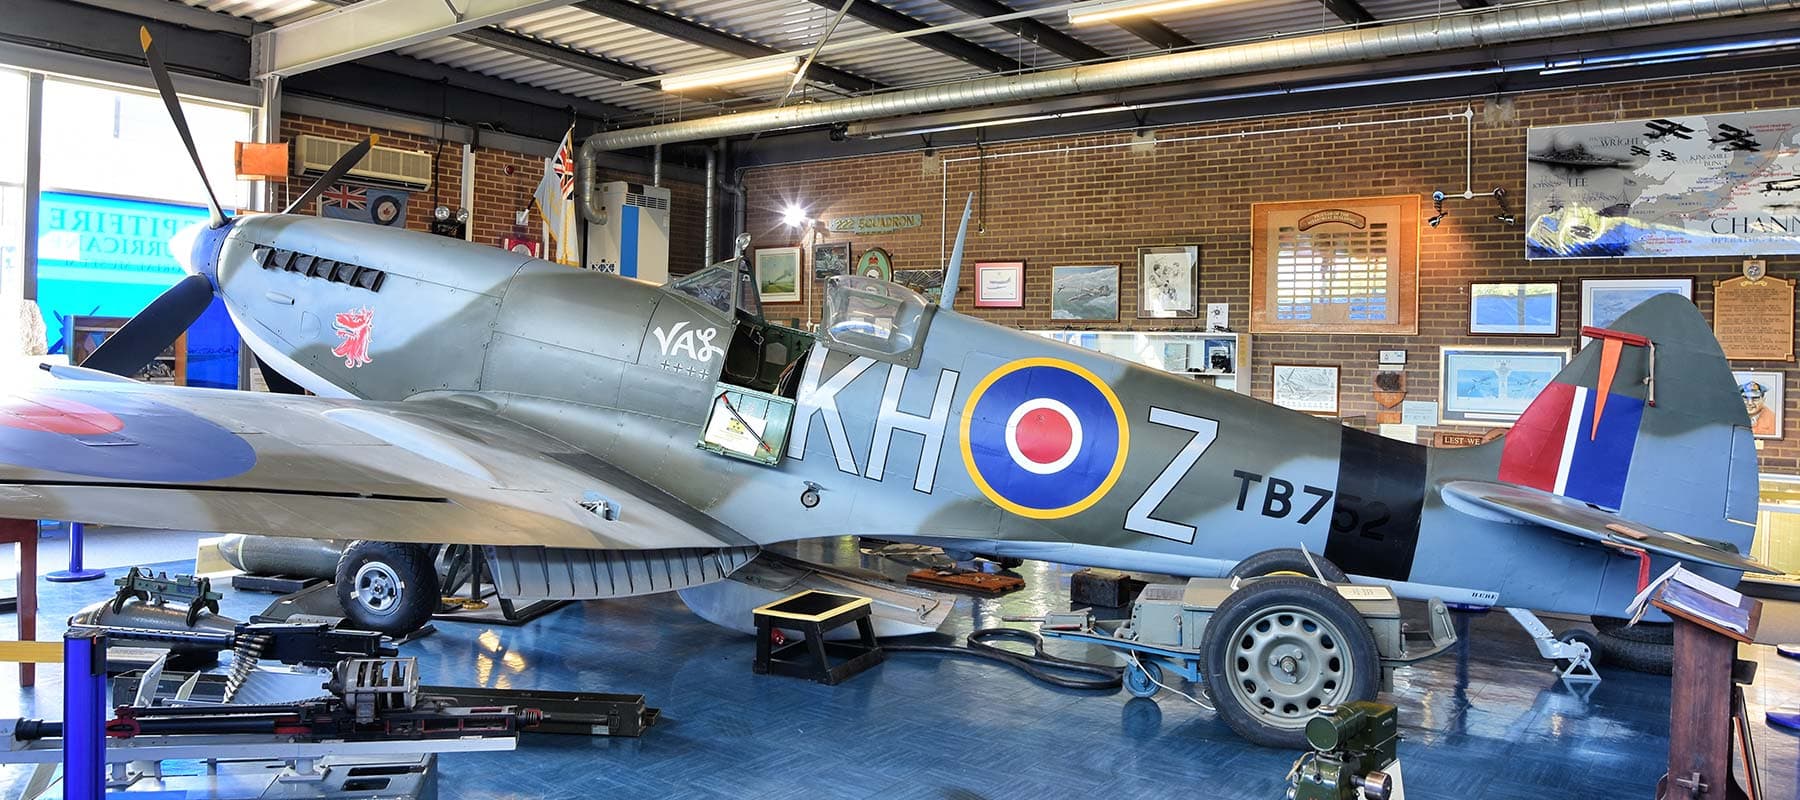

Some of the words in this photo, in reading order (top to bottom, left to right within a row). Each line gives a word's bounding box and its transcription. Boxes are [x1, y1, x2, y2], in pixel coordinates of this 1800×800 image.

[859, 215, 915, 229] SQUADRON
[785, 339, 961, 495] KH
[1444, 436, 1464, 445] LEST
[1467, 438, 1480, 446] WE
[1123, 406, 1220, 545] Z
[1233, 469, 1392, 542] TB752
